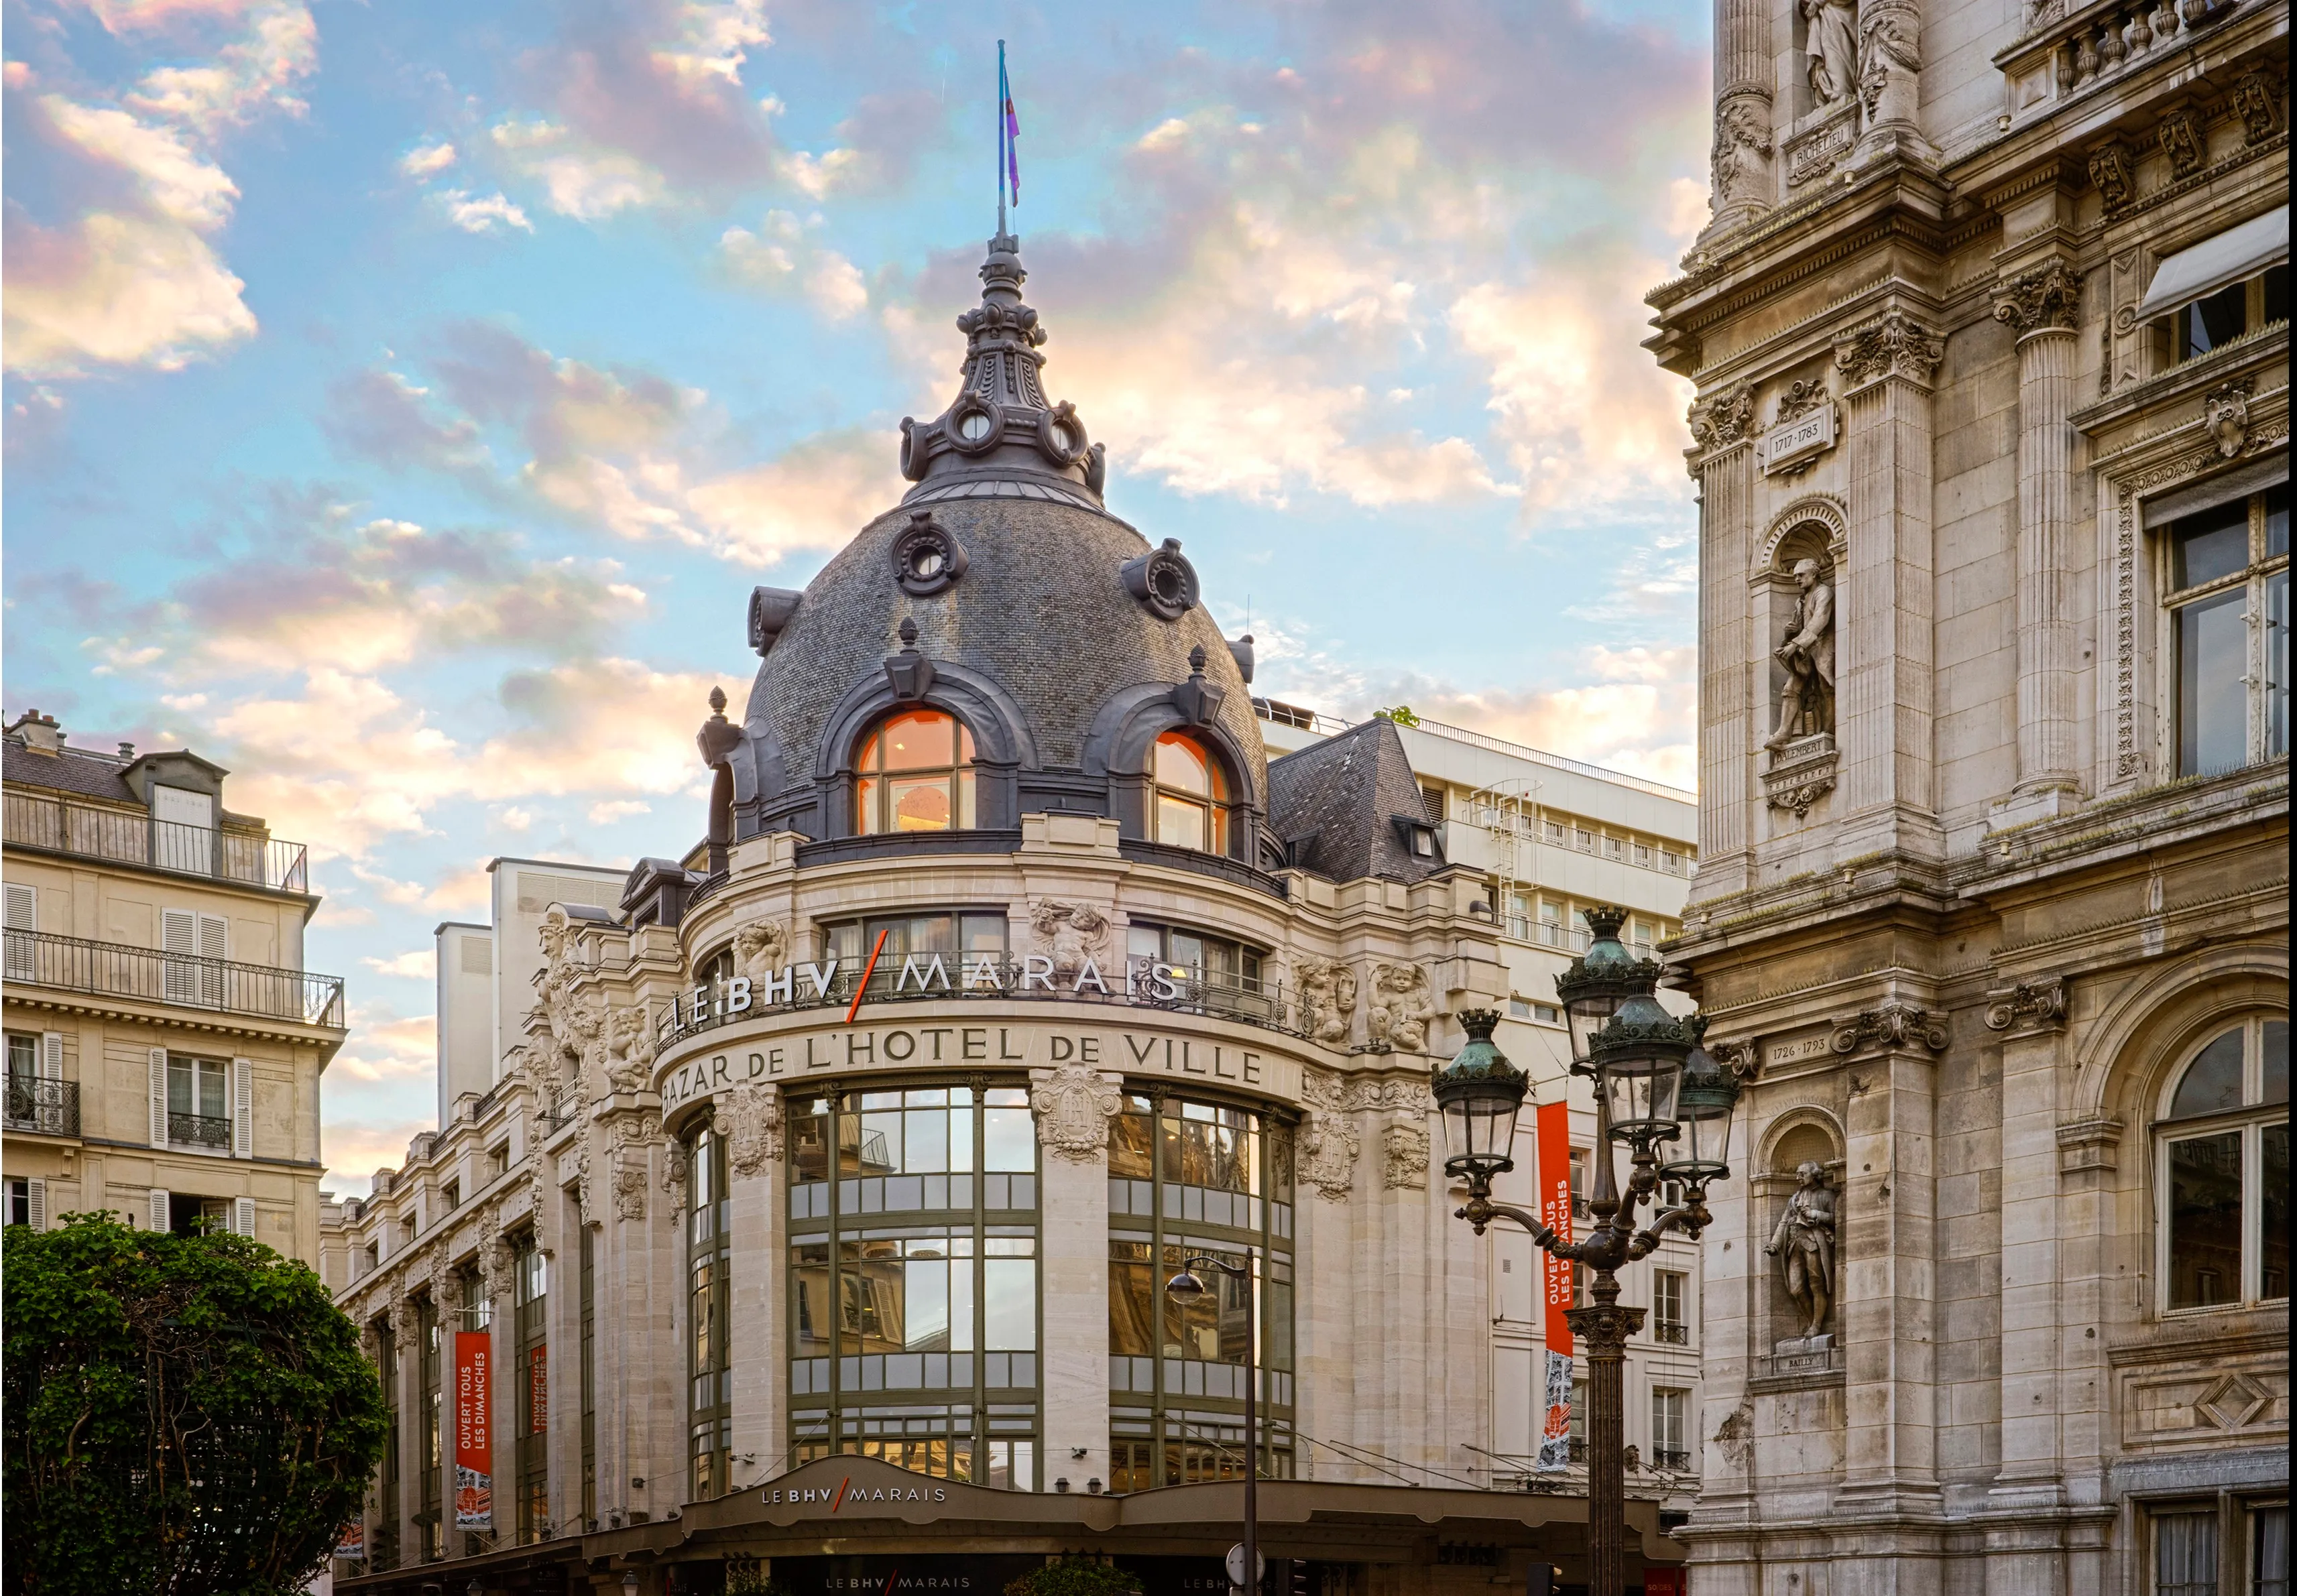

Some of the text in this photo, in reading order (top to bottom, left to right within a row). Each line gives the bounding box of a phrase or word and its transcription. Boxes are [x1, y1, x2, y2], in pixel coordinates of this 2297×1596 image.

[1797, 129, 1843, 165] RICHELIEU
[673, 986, 709, 1032] LE
[662, 1028, 1260, 1115] BAZAR DE L'HOTEL DE VILLE
[1546, 1201, 1559, 1305] OUVER OUS
[1557, 1180, 1570, 1303] LES DANCHES
[1789, 1357, 1814, 1367] BAILLY
[461, 1366, 471, 1449] OUVERT TOUS
[475, 1352, 485, 1449] LES DIMANCHES
[762, 1490, 781, 1503] LE
[826, 1579, 844, 1589] LE
[1184, 1578, 1201, 1589] LE
